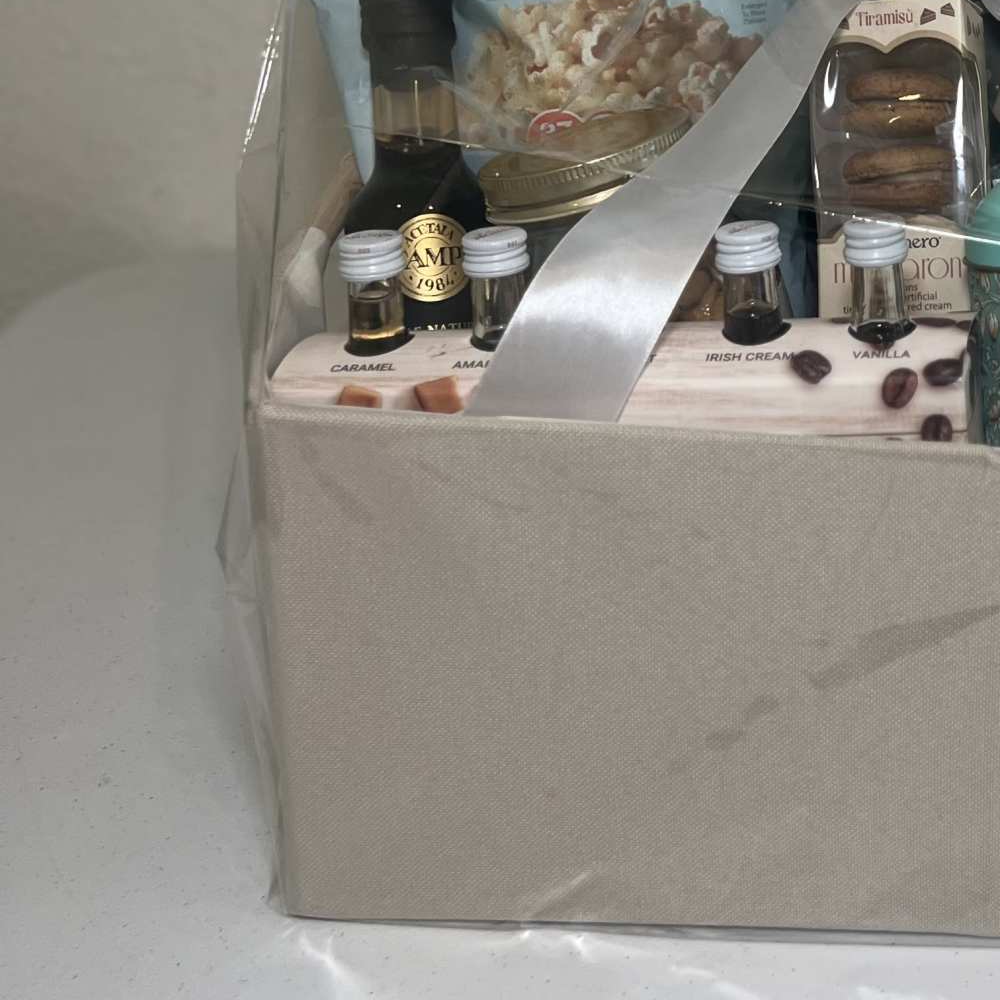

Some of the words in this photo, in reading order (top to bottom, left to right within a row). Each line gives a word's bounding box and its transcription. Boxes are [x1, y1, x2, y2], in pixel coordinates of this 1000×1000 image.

[855, 8, 914, 28] Tiramisù
[924, 301, 953, 311] cream
[705, 352, 741, 362] IRISH
[746, 351, 796, 362] CREAM
[852, 349, 911, 360] VANILLA
[330, 362, 396, 373] CARAMEL
